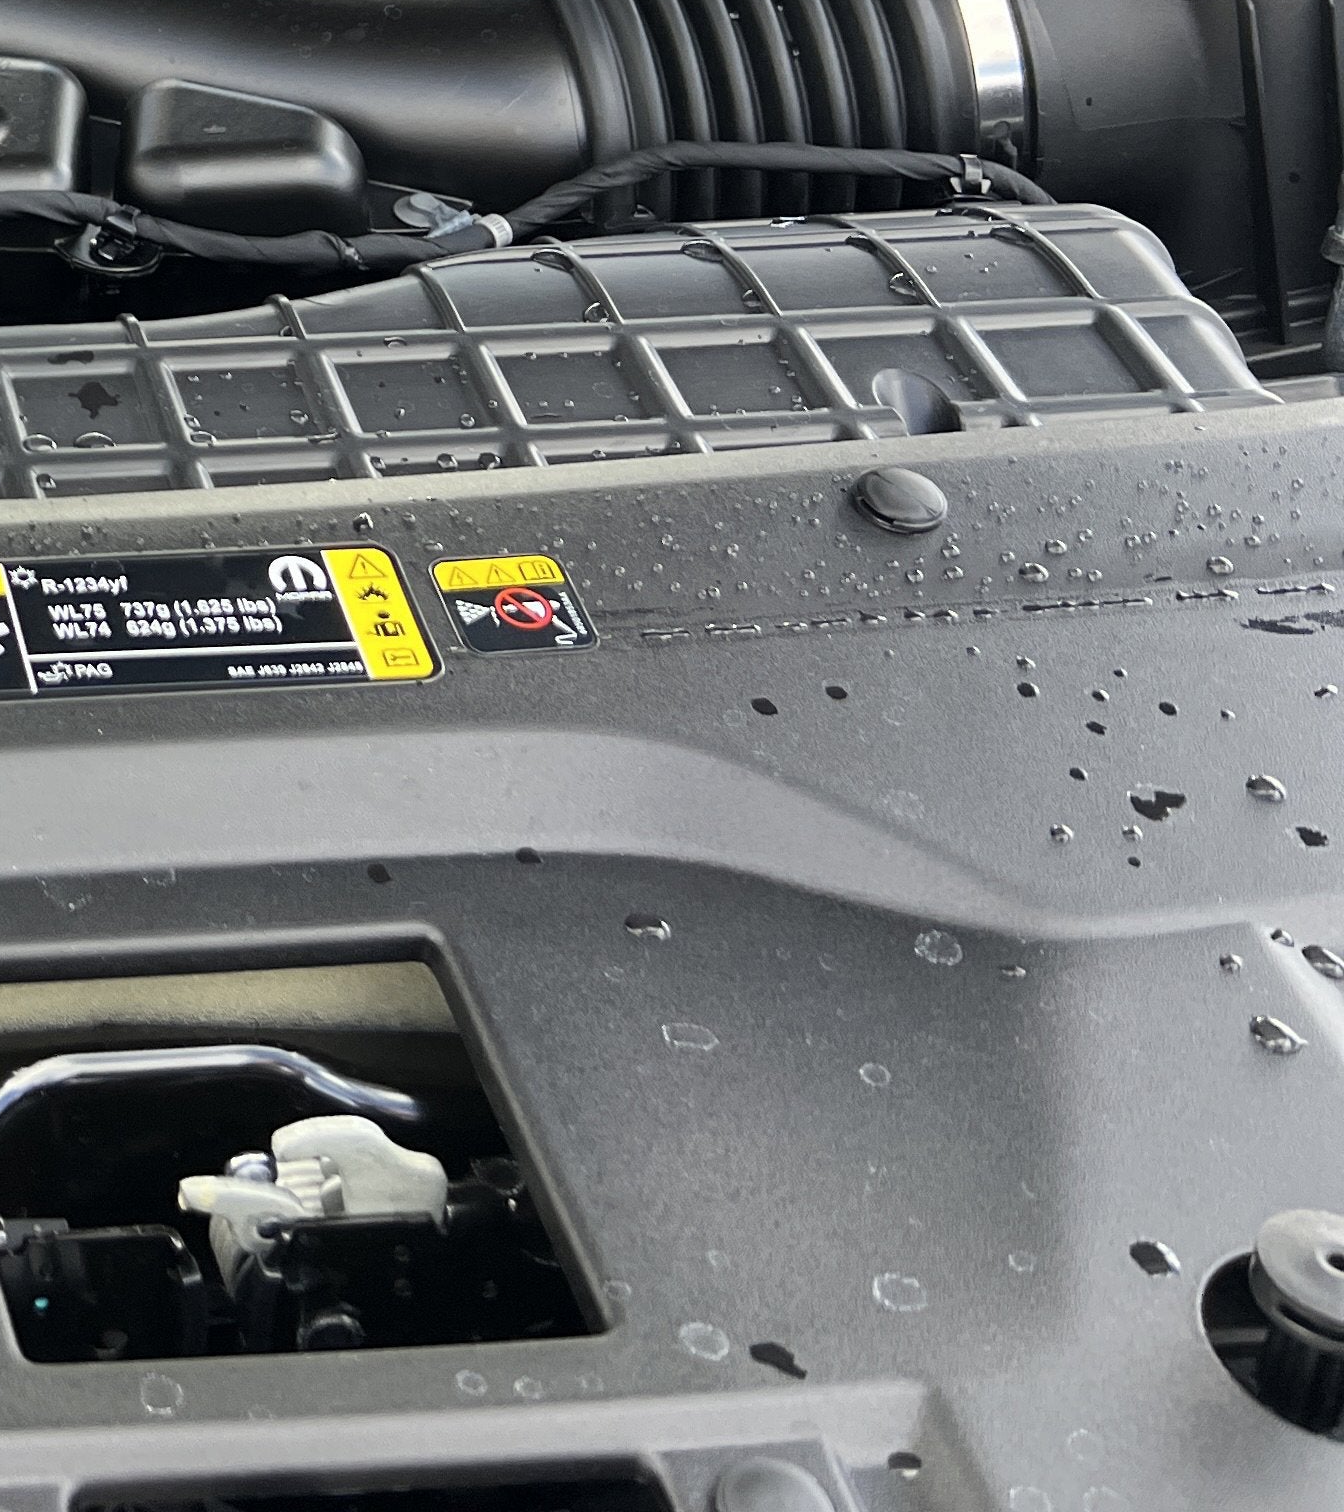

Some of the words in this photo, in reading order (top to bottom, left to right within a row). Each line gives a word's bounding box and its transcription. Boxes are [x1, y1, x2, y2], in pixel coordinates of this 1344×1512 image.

[41, 575, 128, 596] R-1234yf
[48, 603, 107, 622] WL75
[120, 601, 171, 620] 737g
[237, 596, 277, 617] lbs)
[53, 621, 113, 640] WL74
[126, 618, 177, 639] 624g
[179, 616, 240, 638] (1.375
[243, 614, 284, 635] lbs)
[74, 662, 113, 679] PAG
